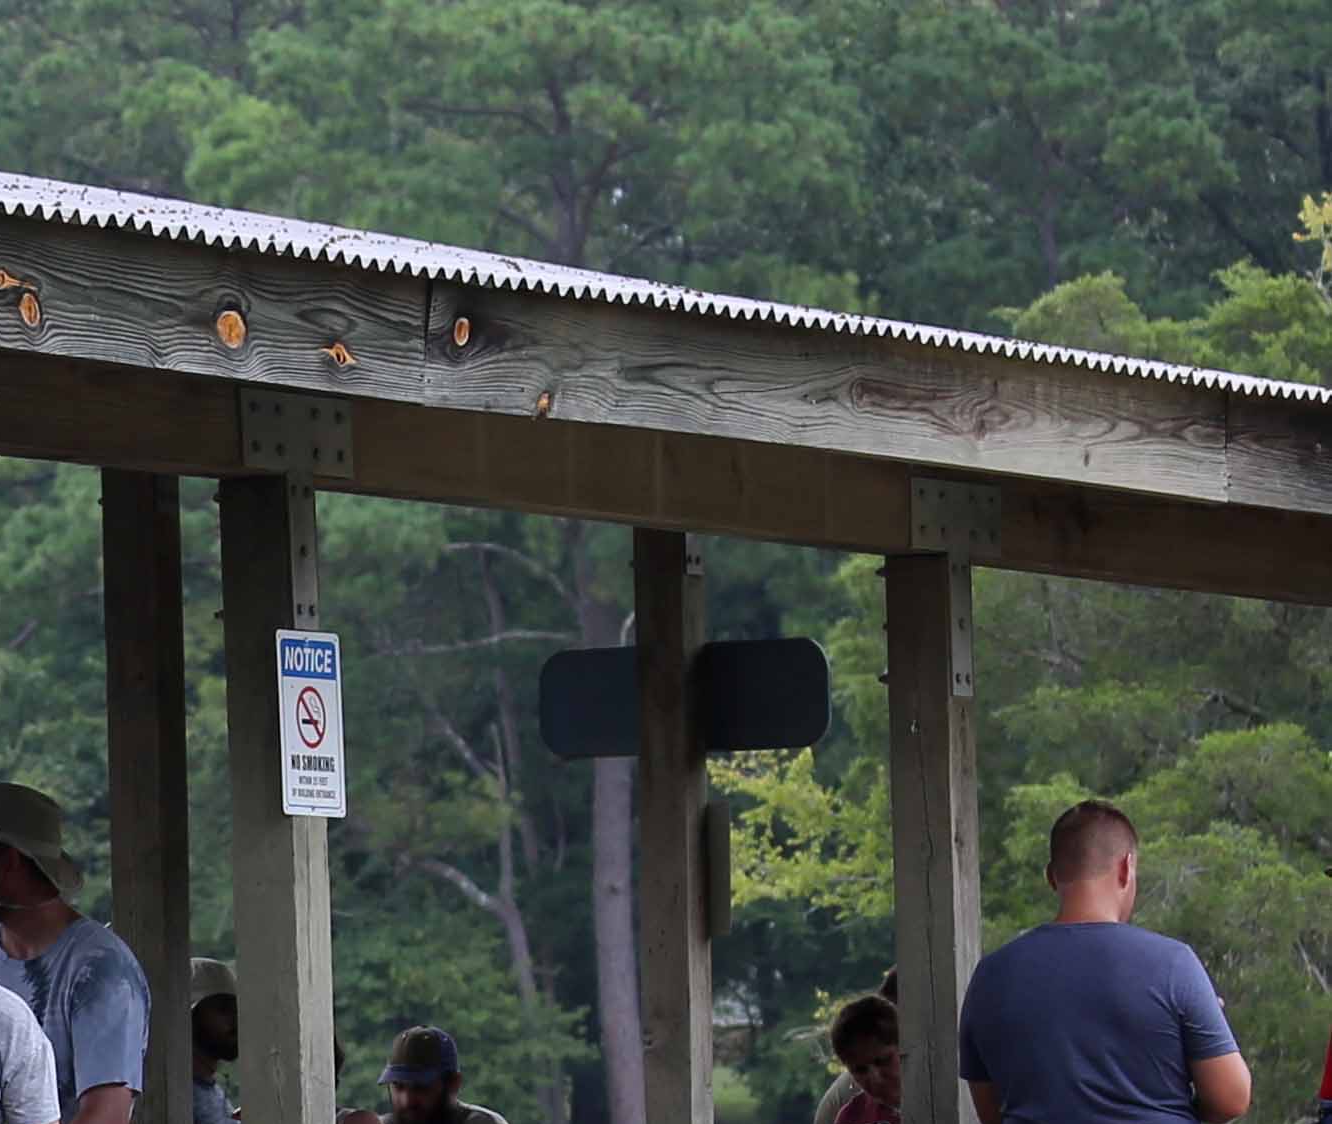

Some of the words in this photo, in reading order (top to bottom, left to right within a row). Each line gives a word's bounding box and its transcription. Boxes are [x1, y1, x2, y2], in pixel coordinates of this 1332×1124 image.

[284, 646, 333, 673] NOTICE
[291, 754, 300, 770] NO
[302, 755, 335, 772] SMOKING
